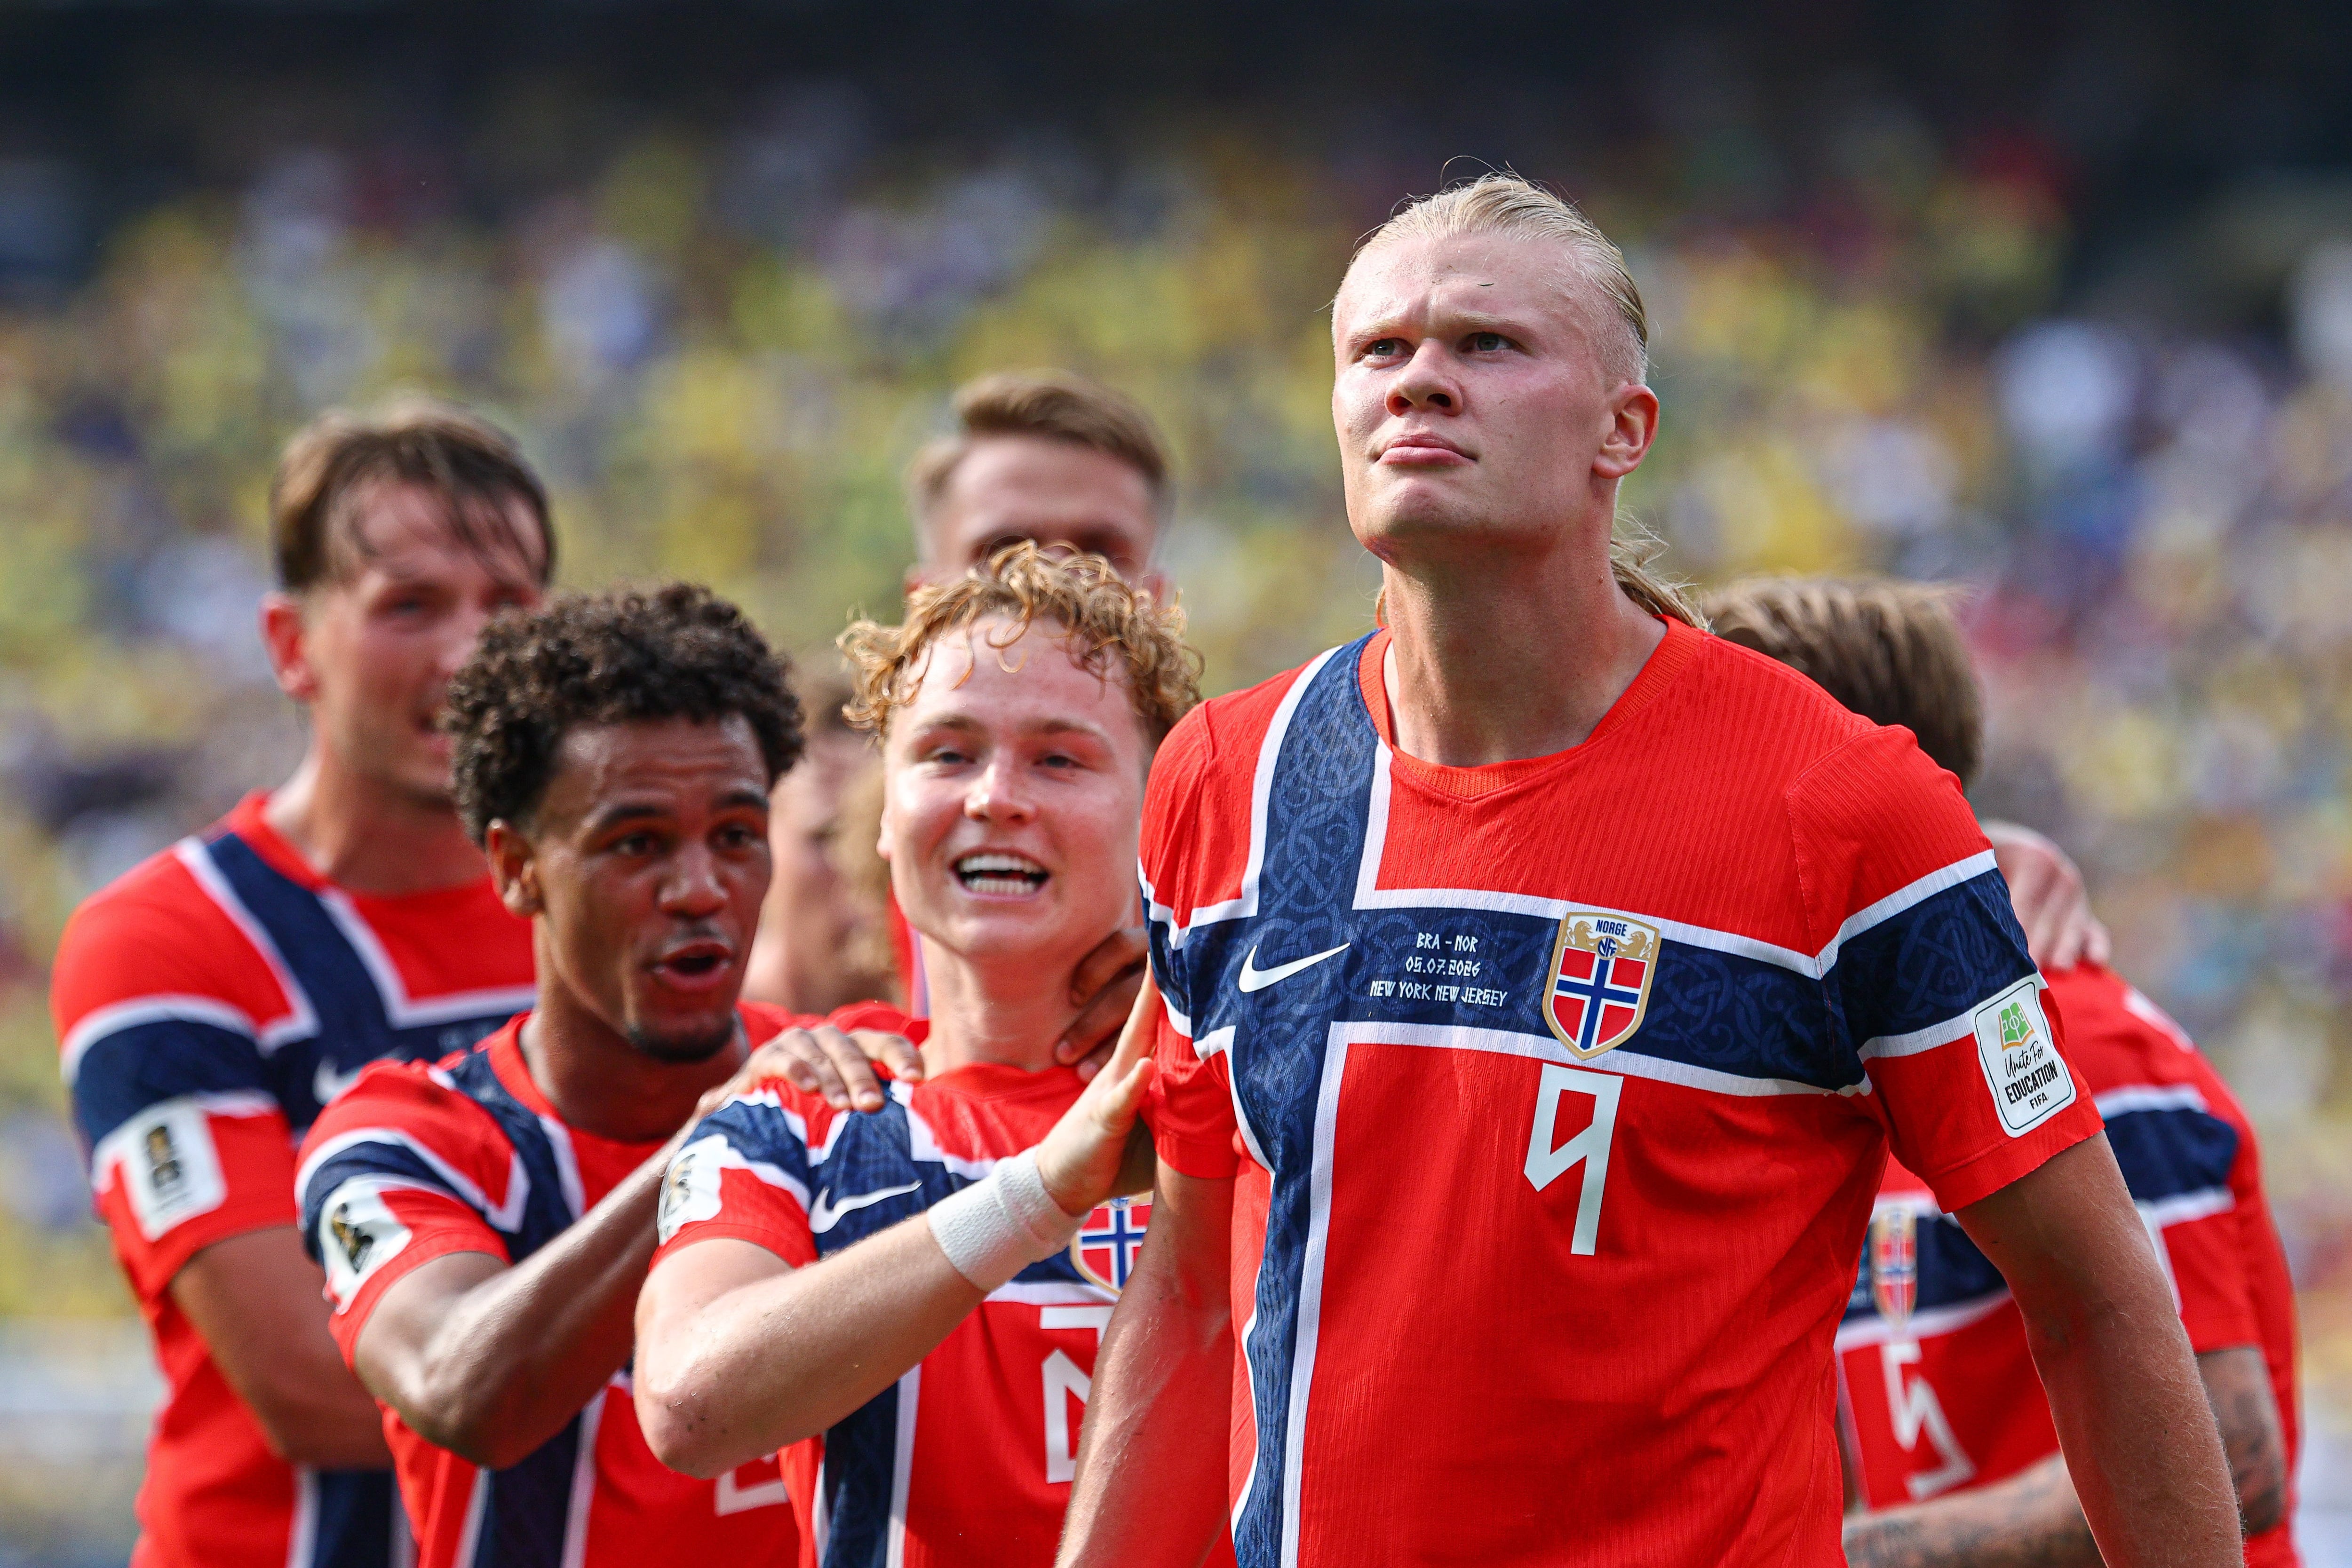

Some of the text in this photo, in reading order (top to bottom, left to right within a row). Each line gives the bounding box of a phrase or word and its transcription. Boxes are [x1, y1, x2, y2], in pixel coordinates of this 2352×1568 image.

[1596, 919, 1628, 936] NORGE
[1416, 932, 1440, 950] BRA
[1454, 935, 1478, 952] NOR
[1406, 956, 1481, 977] 05.07.2026
[1370, 981, 1508, 1007] NEW YORK NEW JERSEY
[2005, 1040, 2043, 1078] Unite For
[2005, 1060, 2058, 1105] EDUCATION
[2029, 1092, 2048, 1110] FIFA
[1523, 1062, 1624, 1256] 9
